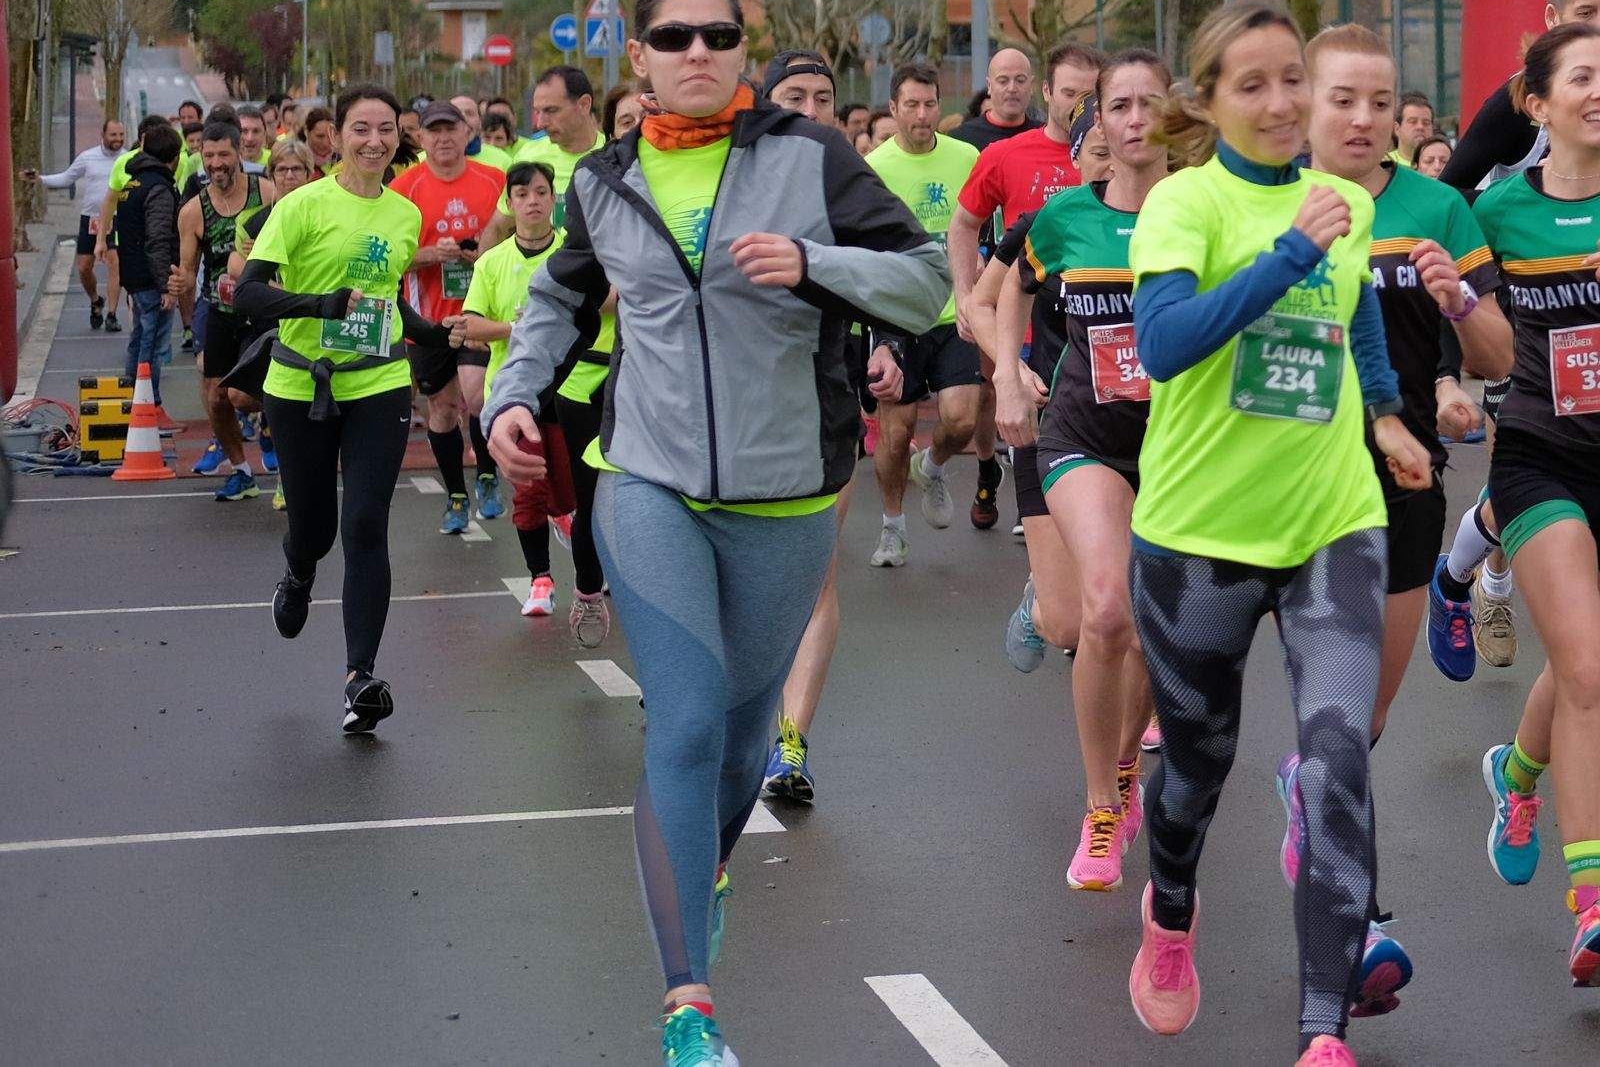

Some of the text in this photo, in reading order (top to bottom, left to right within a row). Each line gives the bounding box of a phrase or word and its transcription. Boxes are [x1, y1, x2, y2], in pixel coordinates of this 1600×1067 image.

[339, 322, 369, 339] 245
[1260, 342, 1327, 368] LAURA
[1119, 363, 1151, 383] 34
[1265, 364, 1318, 395] 234
